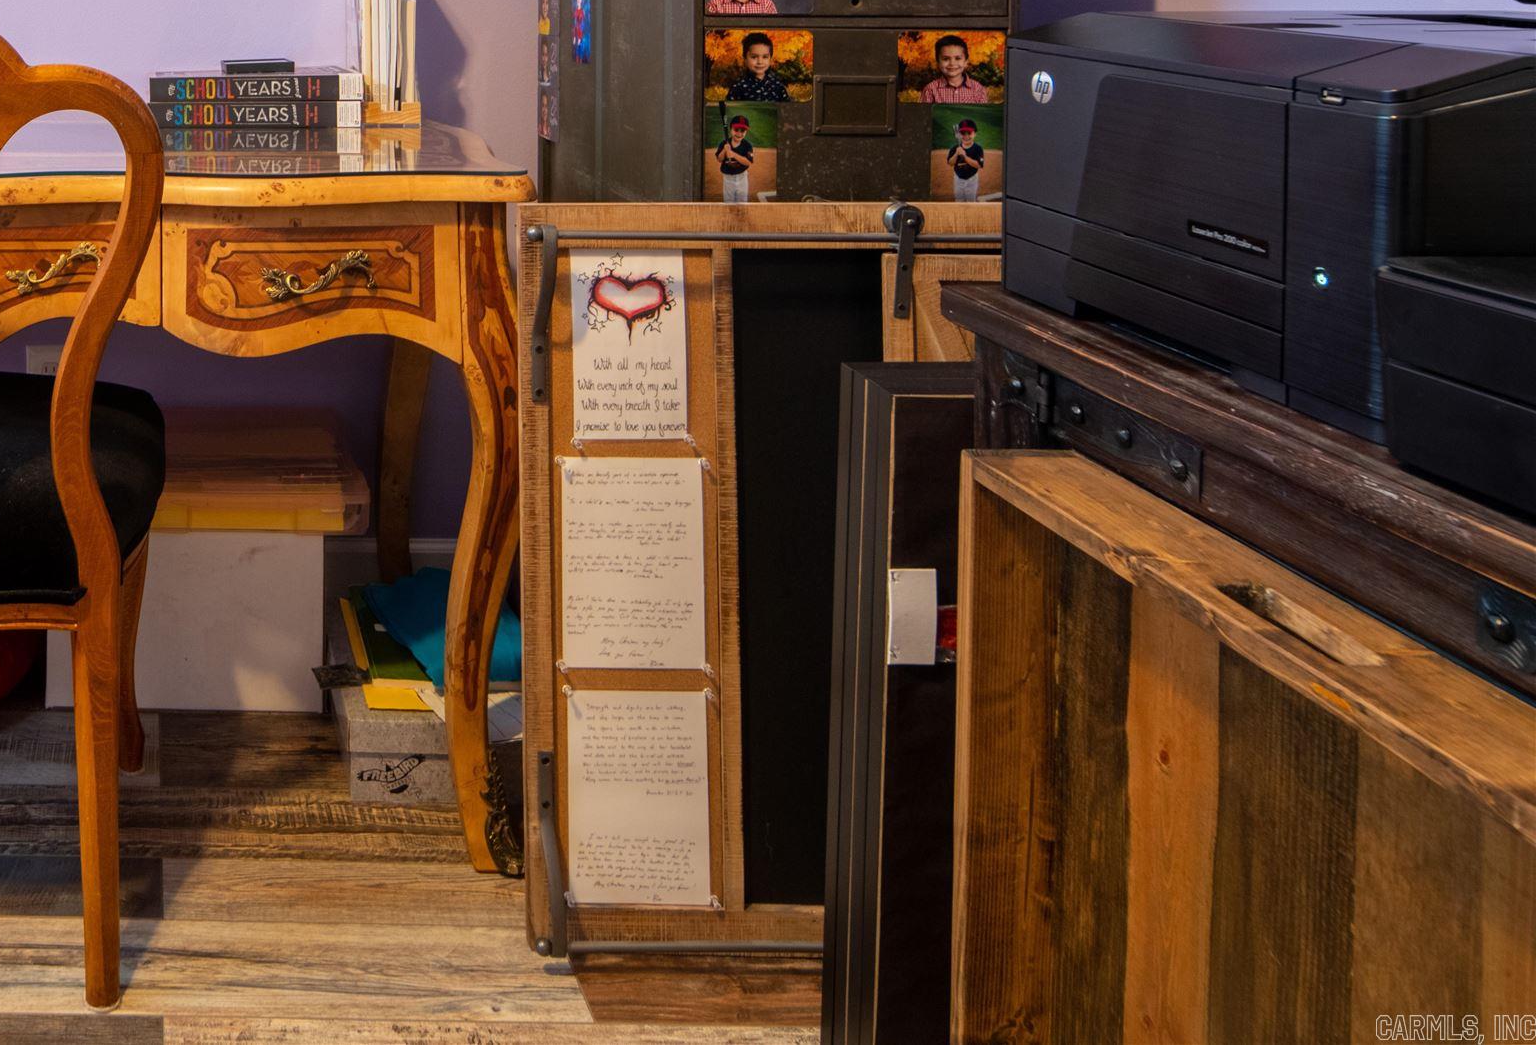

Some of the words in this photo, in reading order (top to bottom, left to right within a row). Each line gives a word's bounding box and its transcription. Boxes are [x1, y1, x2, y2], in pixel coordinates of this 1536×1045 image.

[176, 78, 235, 99] SCHOOL
[234, 80, 292, 96] YEARS
[1033, 71, 1051, 104] hp
[174, 104, 233, 125] SCHOOL
[232, 107, 289, 122] YEARS
[593, 357, 612, 370] With
[617, 358, 628, 370] all
[635, 360, 648, 377] my
[650, 357, 672, 370] heart
[578, 379, 595, 391] With
[597, 382, 616, 397] every
[618, 379, 633, 391] inch
[635, 381, 646, 395] of
[647, 382, 659, 398] my
[581, 399, 599, 411] With
[602, 402, 622, 417] every
[625, 399, 651, 411] breath
[662, 399, 680, 411] take
[582, 422, 609, 437] promise
[614, 420, 621, 431] to
[624, 420, 640, 432] love
[641, 423, 658, 438] you
